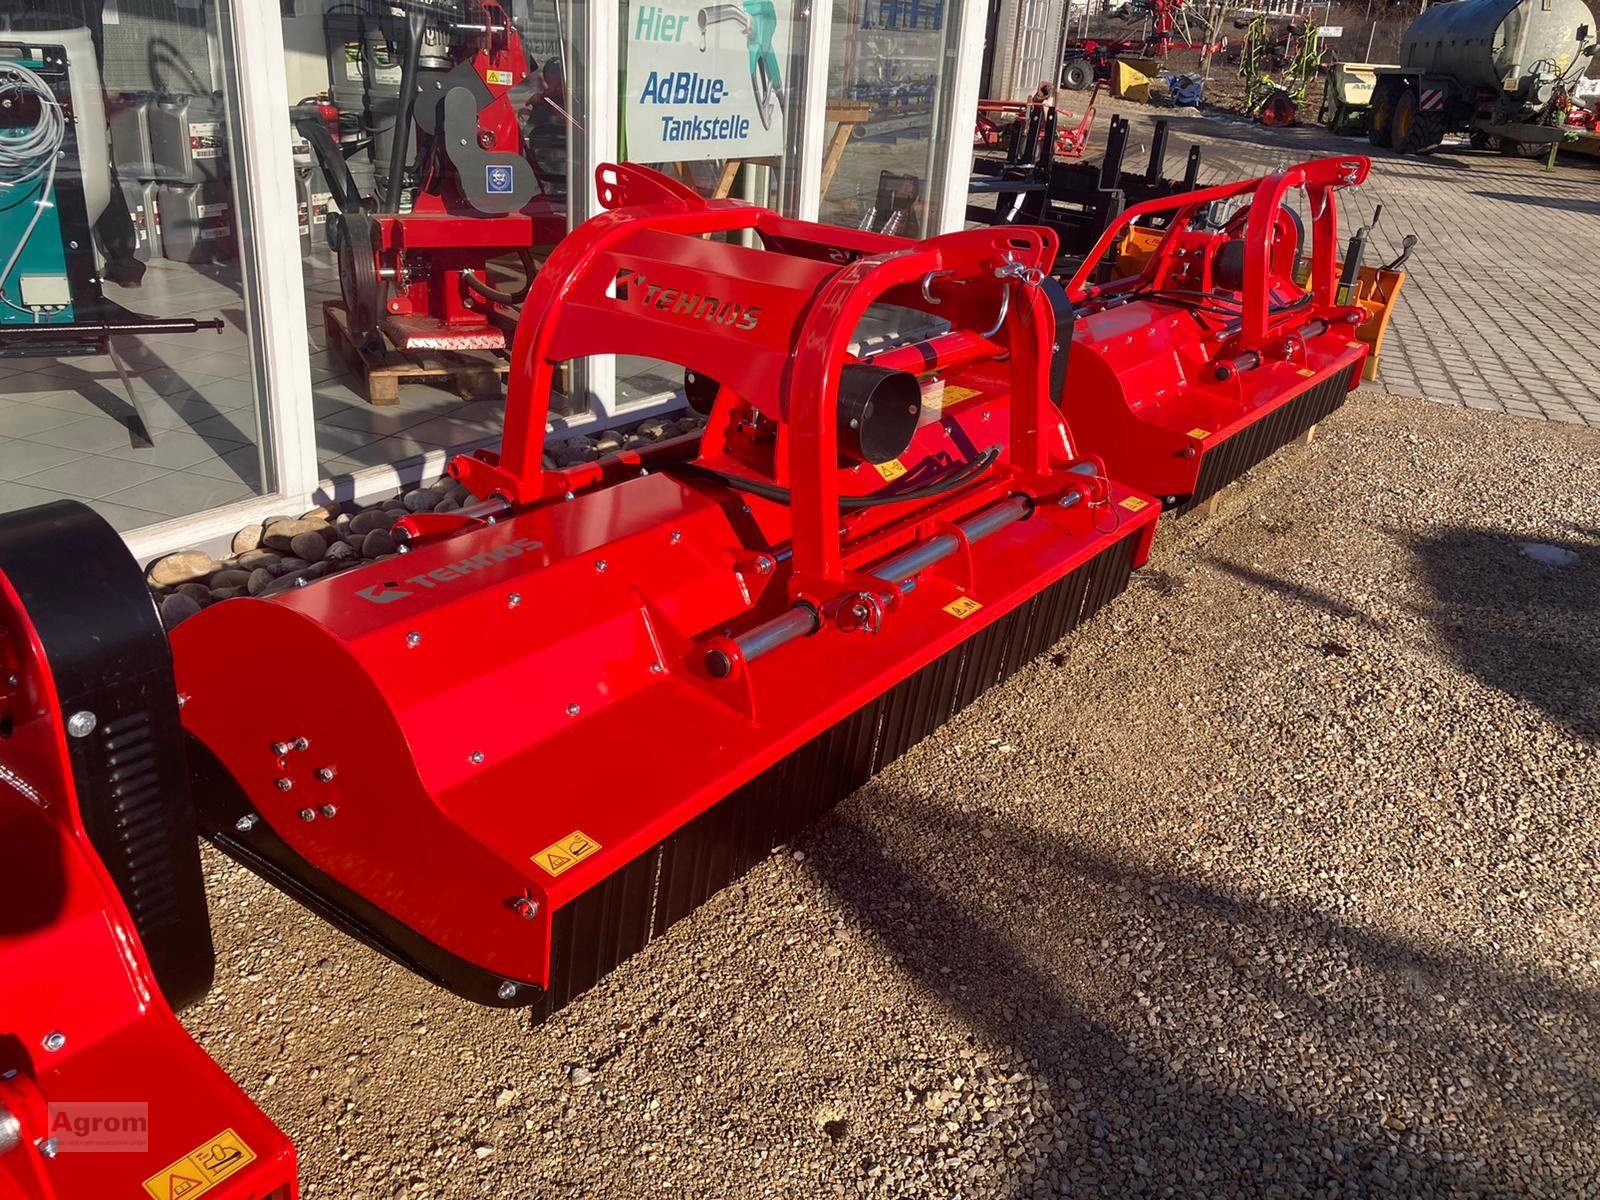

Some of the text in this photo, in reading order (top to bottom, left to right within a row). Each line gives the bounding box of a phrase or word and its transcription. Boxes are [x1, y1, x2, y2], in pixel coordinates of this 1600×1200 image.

[634, 6, 689, 42] Hier
[639, 71, 729, 105] AdBlue-
[661, 115, 750, 141] Tankstelle
[642, 284, 764, 331] TEHNOS
[404, 538, 544, 589] TEHNOS
